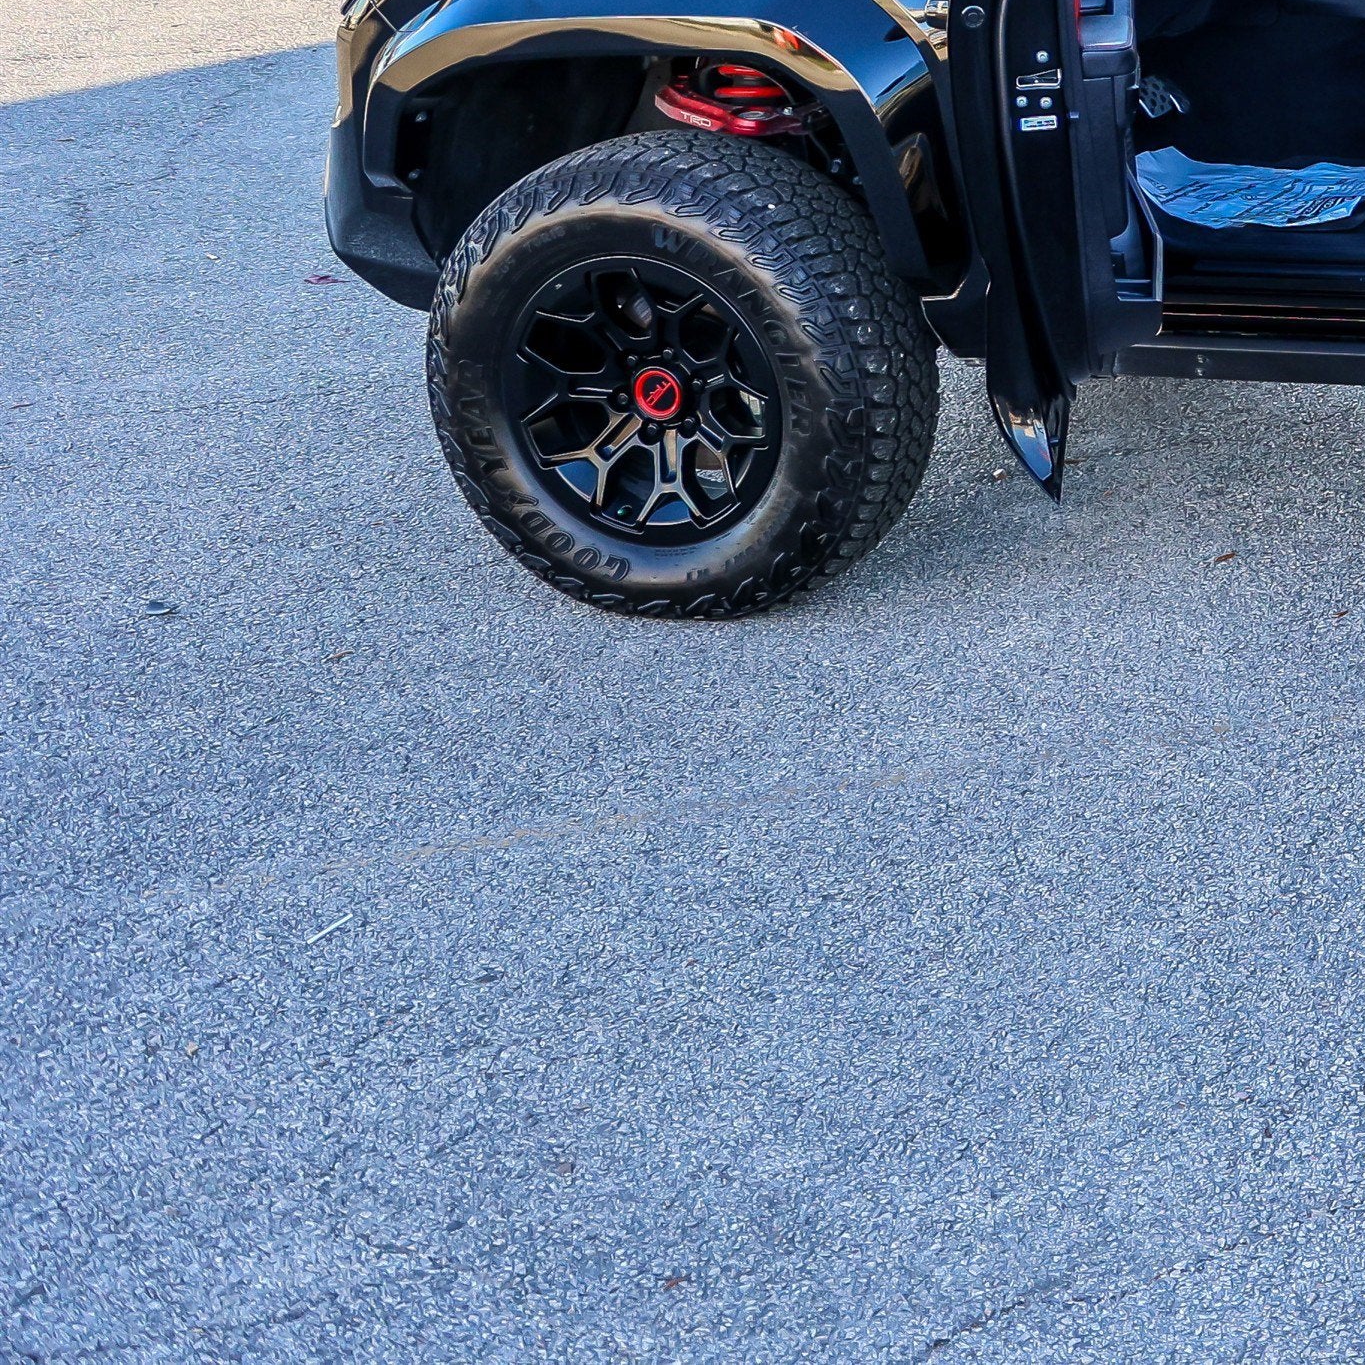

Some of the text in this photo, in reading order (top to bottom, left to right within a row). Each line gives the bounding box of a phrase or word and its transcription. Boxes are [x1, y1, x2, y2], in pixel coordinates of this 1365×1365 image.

[680, 110, 712, 127] TRD
[650, 223, 814, 438] WRANGLER
[457, 357, 632, 583] GOODYEAR
